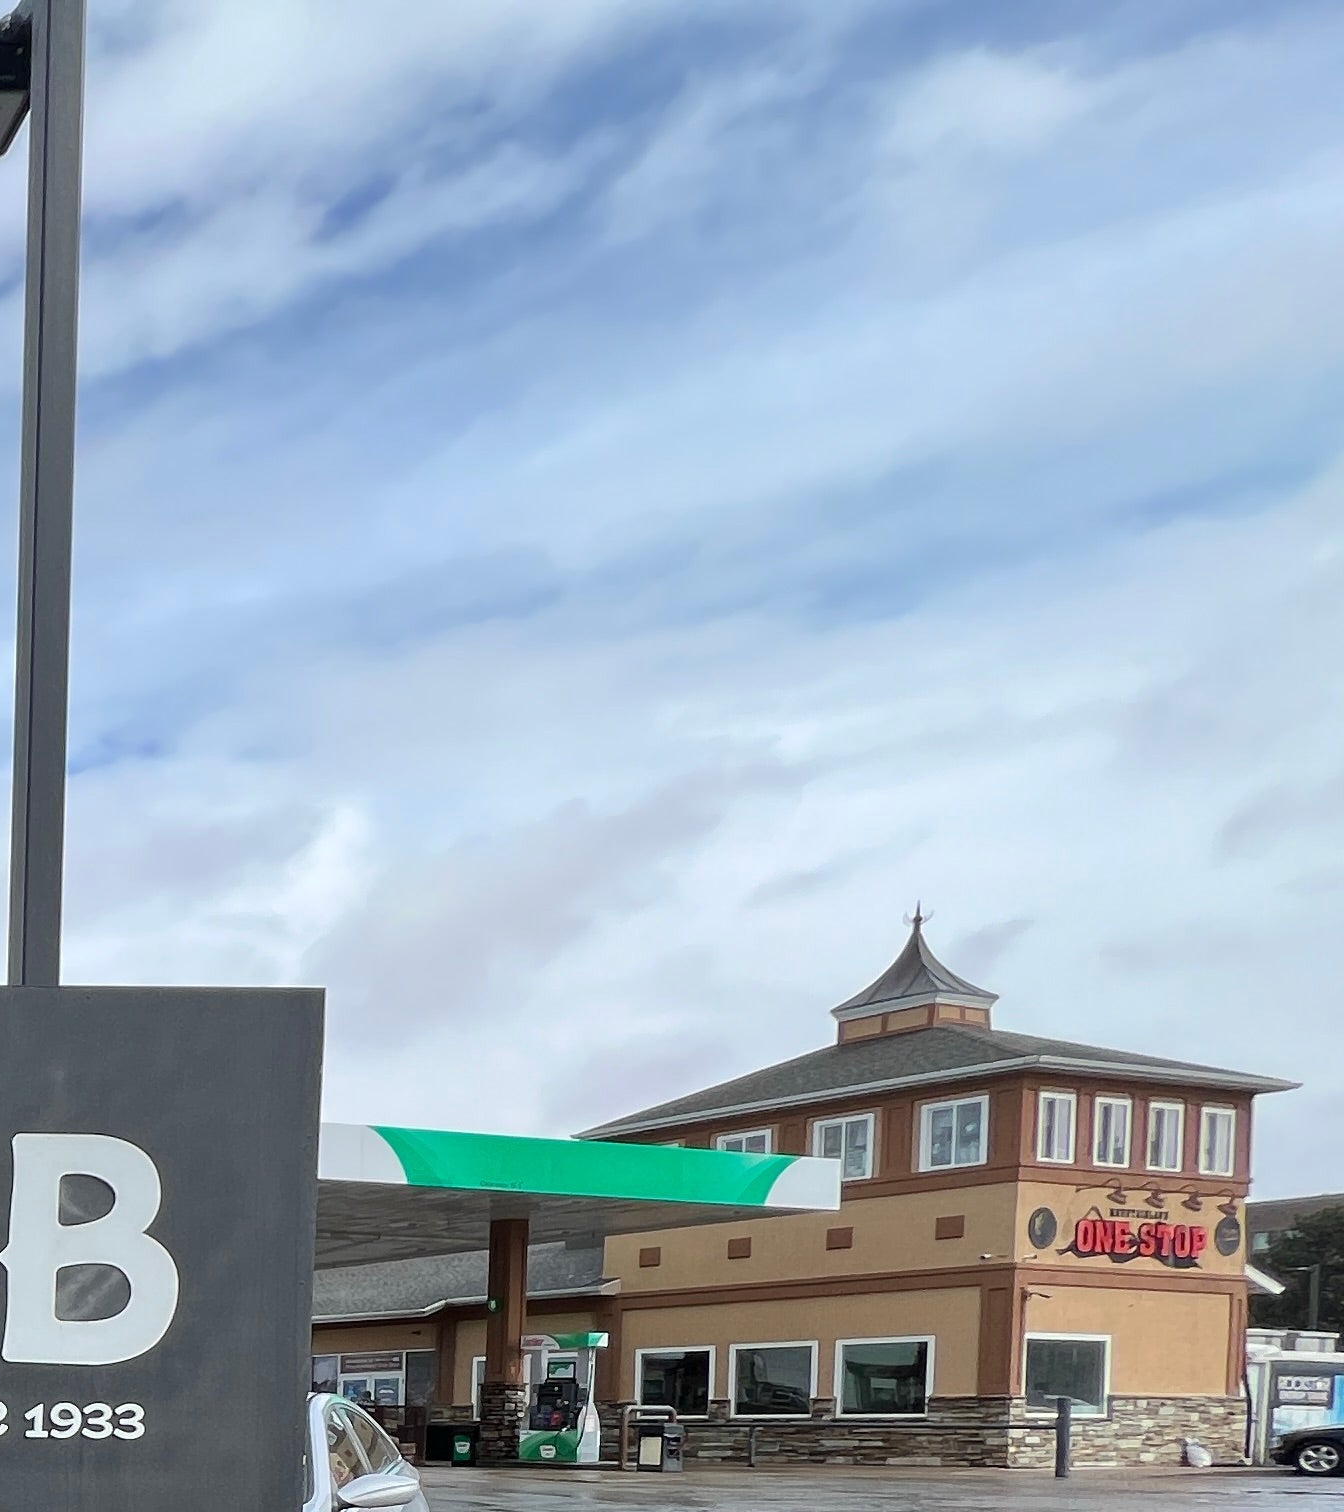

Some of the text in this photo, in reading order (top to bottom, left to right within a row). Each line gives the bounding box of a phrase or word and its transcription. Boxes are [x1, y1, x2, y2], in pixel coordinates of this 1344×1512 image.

[1076, 1219, 1208, 1259] ONE STOP
[23, 1402, 146, 1440] 1933
